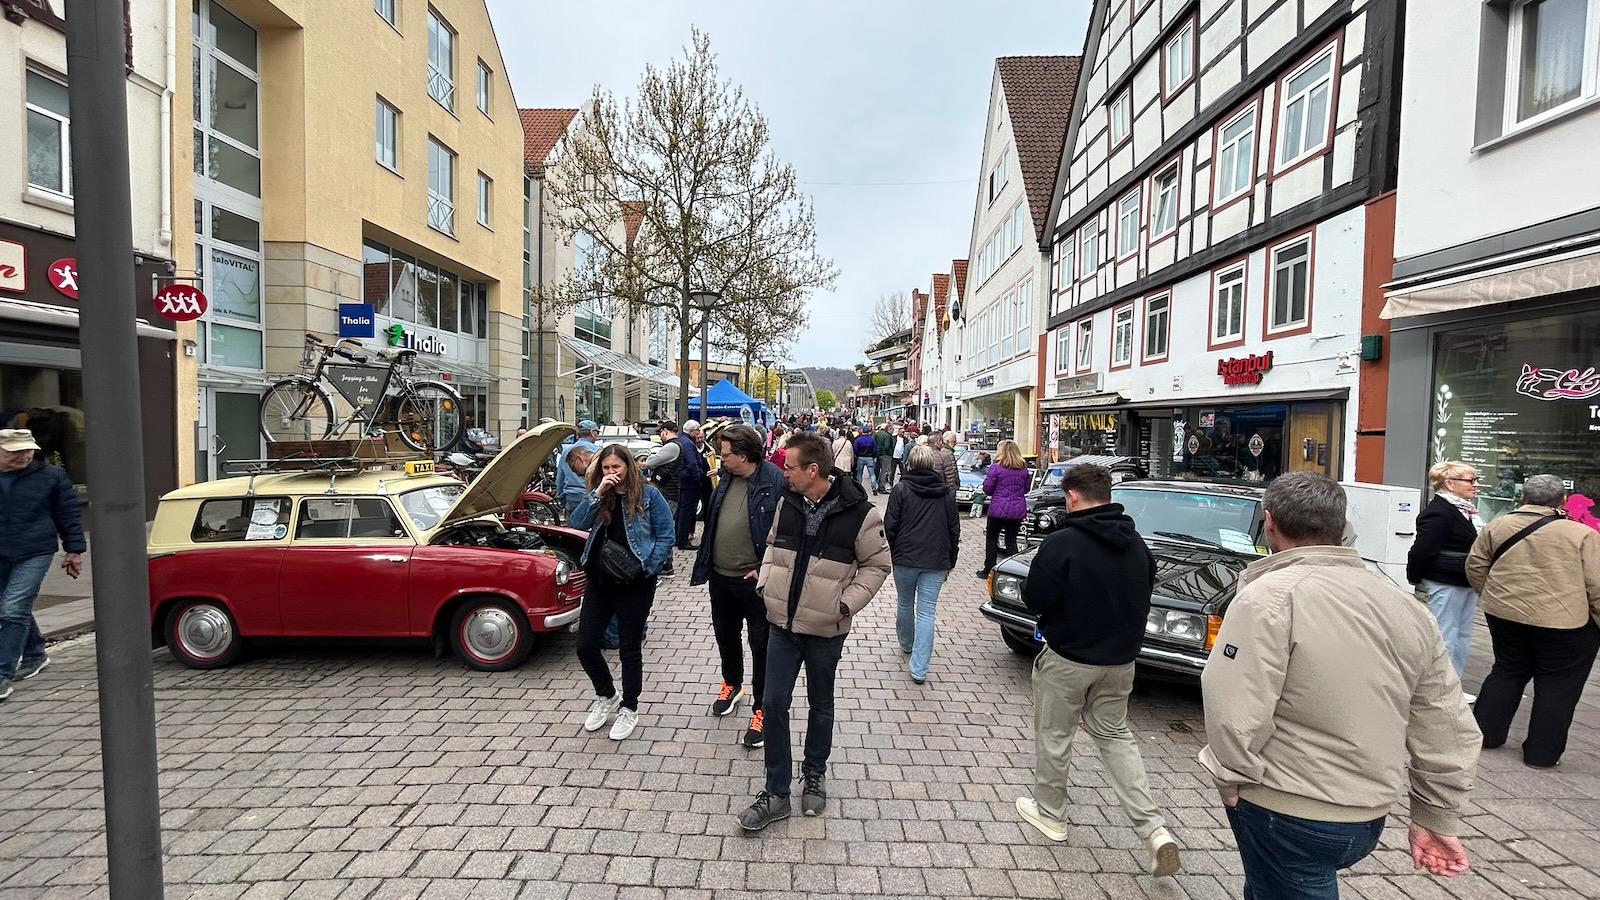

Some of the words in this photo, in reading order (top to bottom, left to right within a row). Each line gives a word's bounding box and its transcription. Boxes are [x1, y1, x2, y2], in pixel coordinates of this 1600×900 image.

[341, 316, 370, 325] Thalia
[404, 330, 447, 355] Thalia
[1060, 414, 1088, 430] BEAUTY
[1089, 412, 1115, 431] NAILS
[415, 463, 434, 473] TAXI
